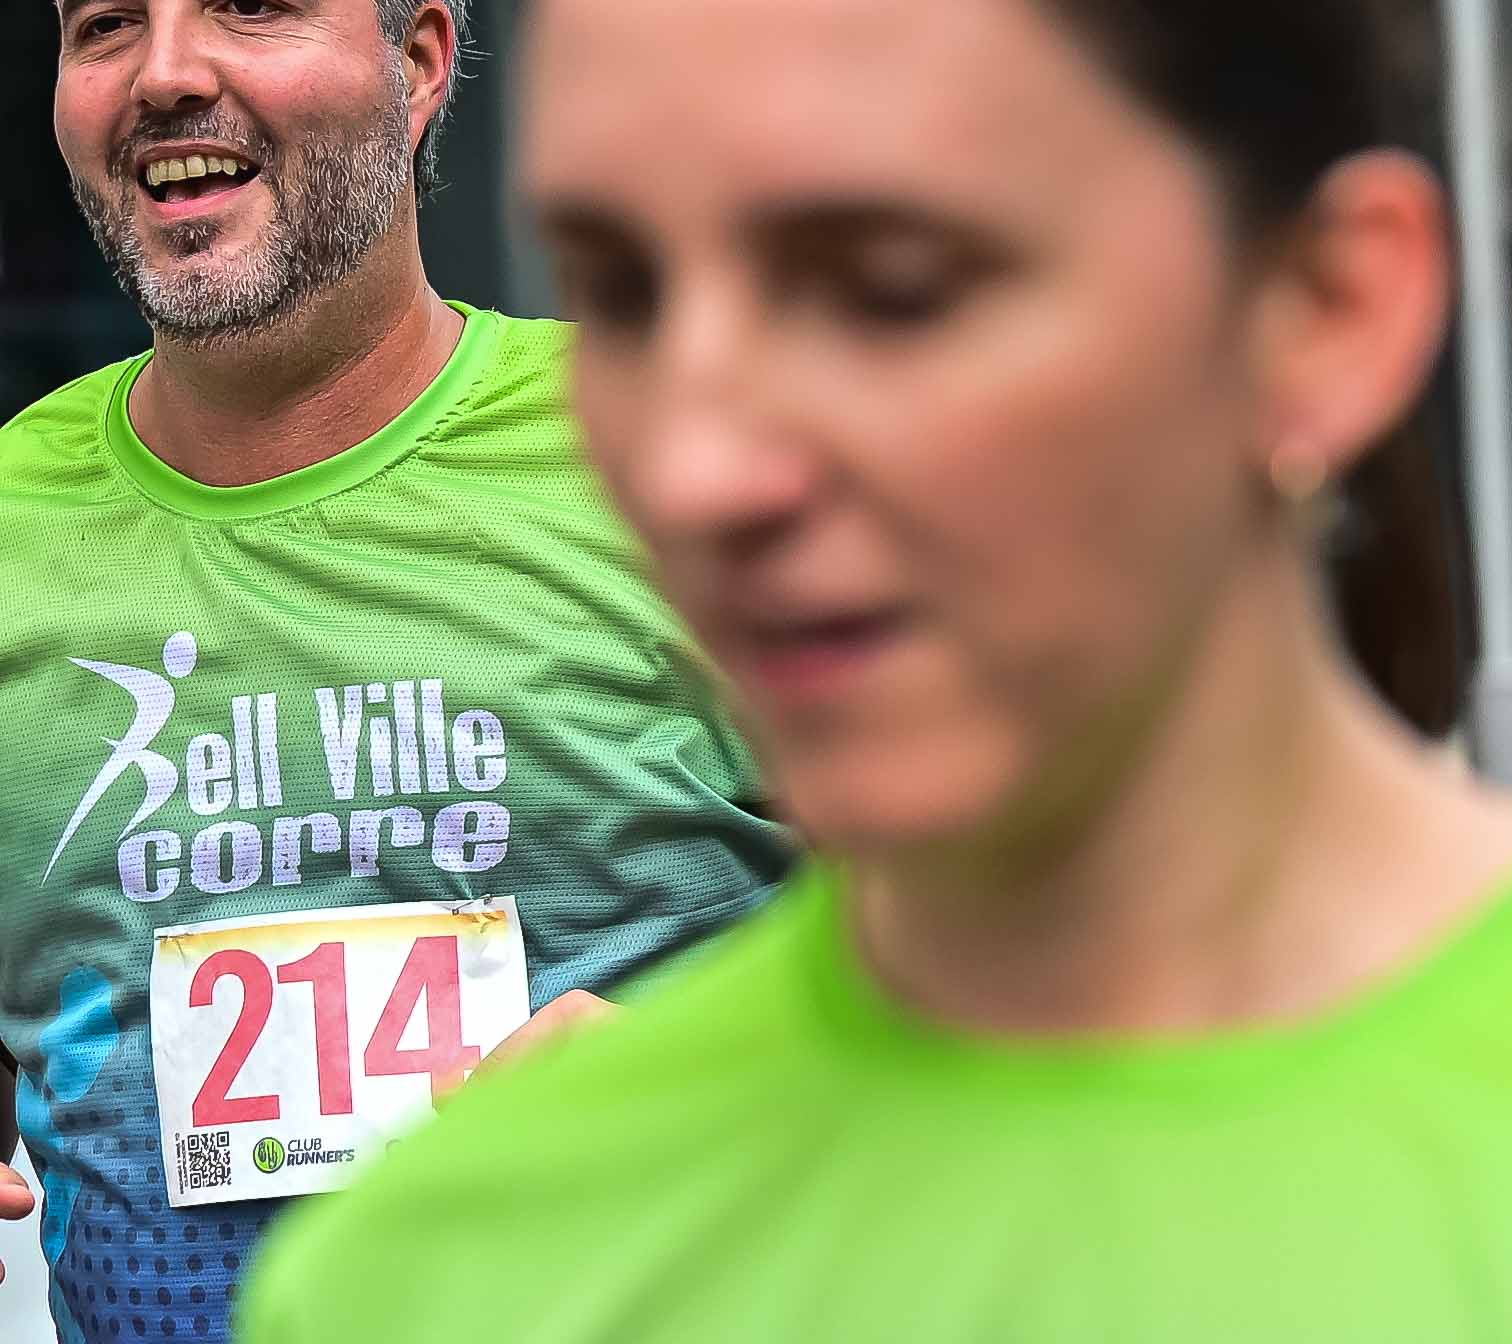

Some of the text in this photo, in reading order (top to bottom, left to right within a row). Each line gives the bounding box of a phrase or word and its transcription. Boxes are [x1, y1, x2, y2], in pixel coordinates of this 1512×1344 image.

[314, 678, 508, 800] Ville
[117, 801, 511, 903] corre
[188, 934, 482, 1128] 214
[287, 1149, 355, 1167] RUNNER'S
[288, 1138, 322, 1152] CLUB
